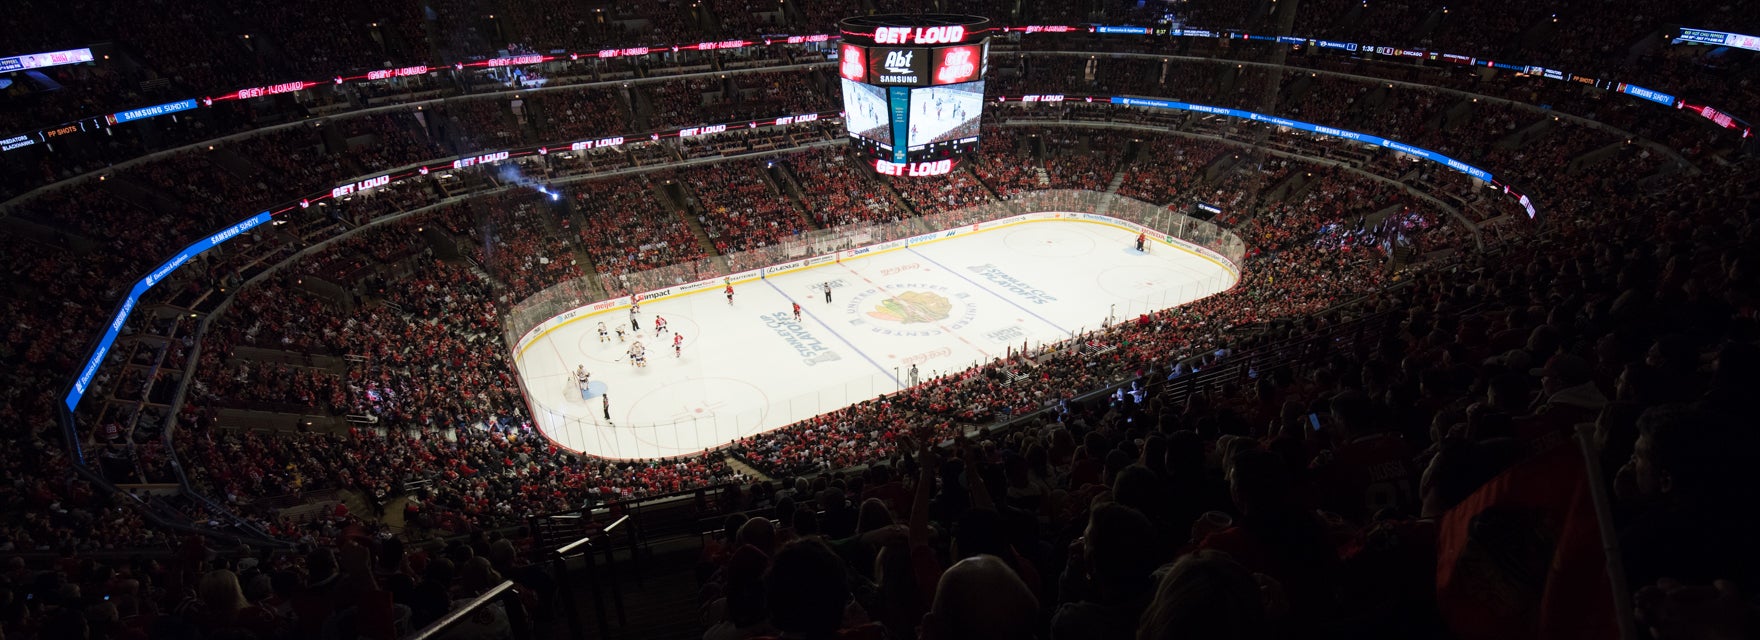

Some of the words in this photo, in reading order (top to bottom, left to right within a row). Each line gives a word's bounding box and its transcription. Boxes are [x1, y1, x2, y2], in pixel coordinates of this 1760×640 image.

[875, 27, 911, 44] GET
[914, 26, 964, 44] LOUD
[885, 50, 913, 68] Abt
[880, 75, 917, 83] SAMSUNG
[1631, 86, 1653, 99] SAMSUNG
[124, 106, 163, 120] SAMSUNG
[775, 116, 794, 125] GET
[795, 113, 817, 123] LOUD
[57, 126, 77, 136] SHOTS
[679, 127, 700, 137] GET
[701, 124, 726, 135] LOUD
[1315, 126, 1340, 136] SAMSUNG
[572, 141, 593, 151] GET
[595, 137, 624, 147] LOUD
[454, 157, 476, 169] GET
[479, 151, 509, 164] LOUD
[1448, 159, 1469, 172] SAMSUNG
[876, 160, 906, 176] GET
[909, 160, 951, 177] LOUD
[332, 184, 356, 199] GET
[358, 175, 390, 191] LOUD
[211, 226, 239, 244] SAMSUNG
[776, 263, 800, 271] LEXUS
[643, 289, 671, 301] impact
[848, 289, 876, 314] UNITED
[886, 283, 949, 291] CENTER
[593, 301, 615, 311] meijer
[564, 311, 577, 320] AT&T
